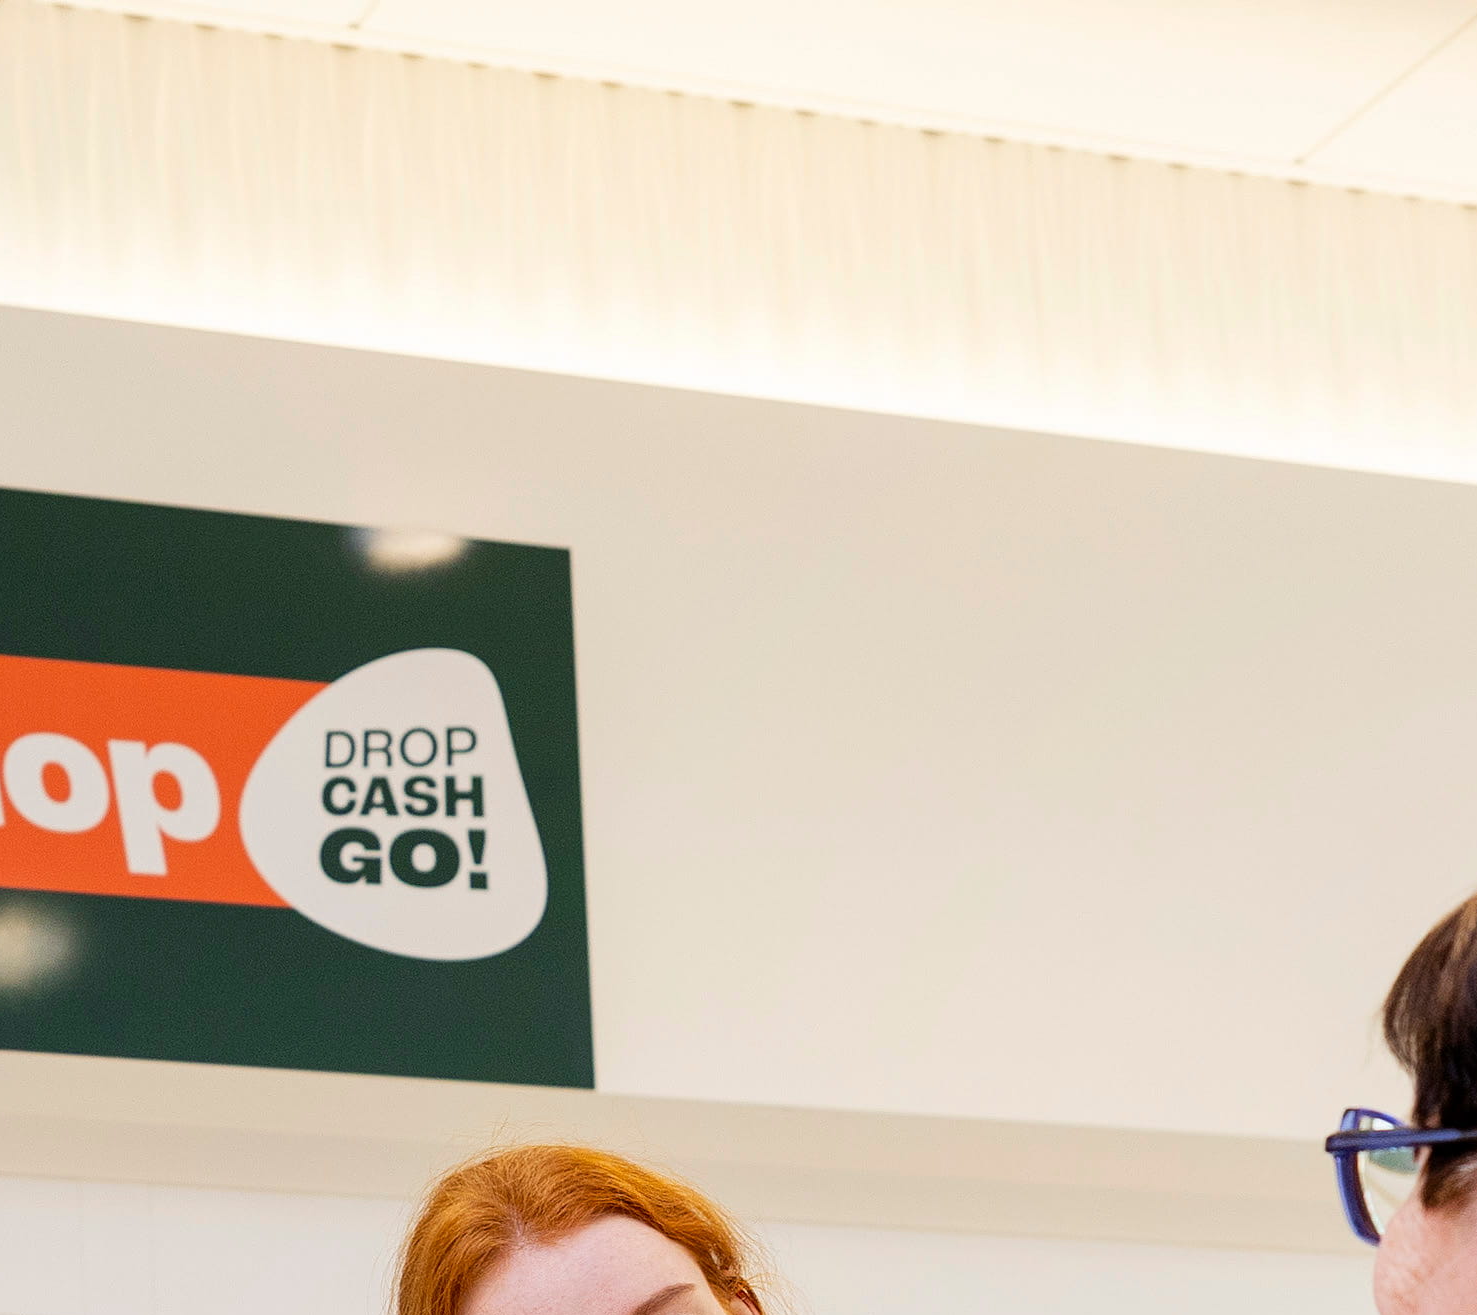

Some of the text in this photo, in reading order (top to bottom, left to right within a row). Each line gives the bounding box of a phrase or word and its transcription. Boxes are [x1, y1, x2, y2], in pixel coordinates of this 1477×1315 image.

[324, 727, 477, 768] DROP
[321, 775, 484, 817] CASH
[319, 827, 488, 890] GO!
